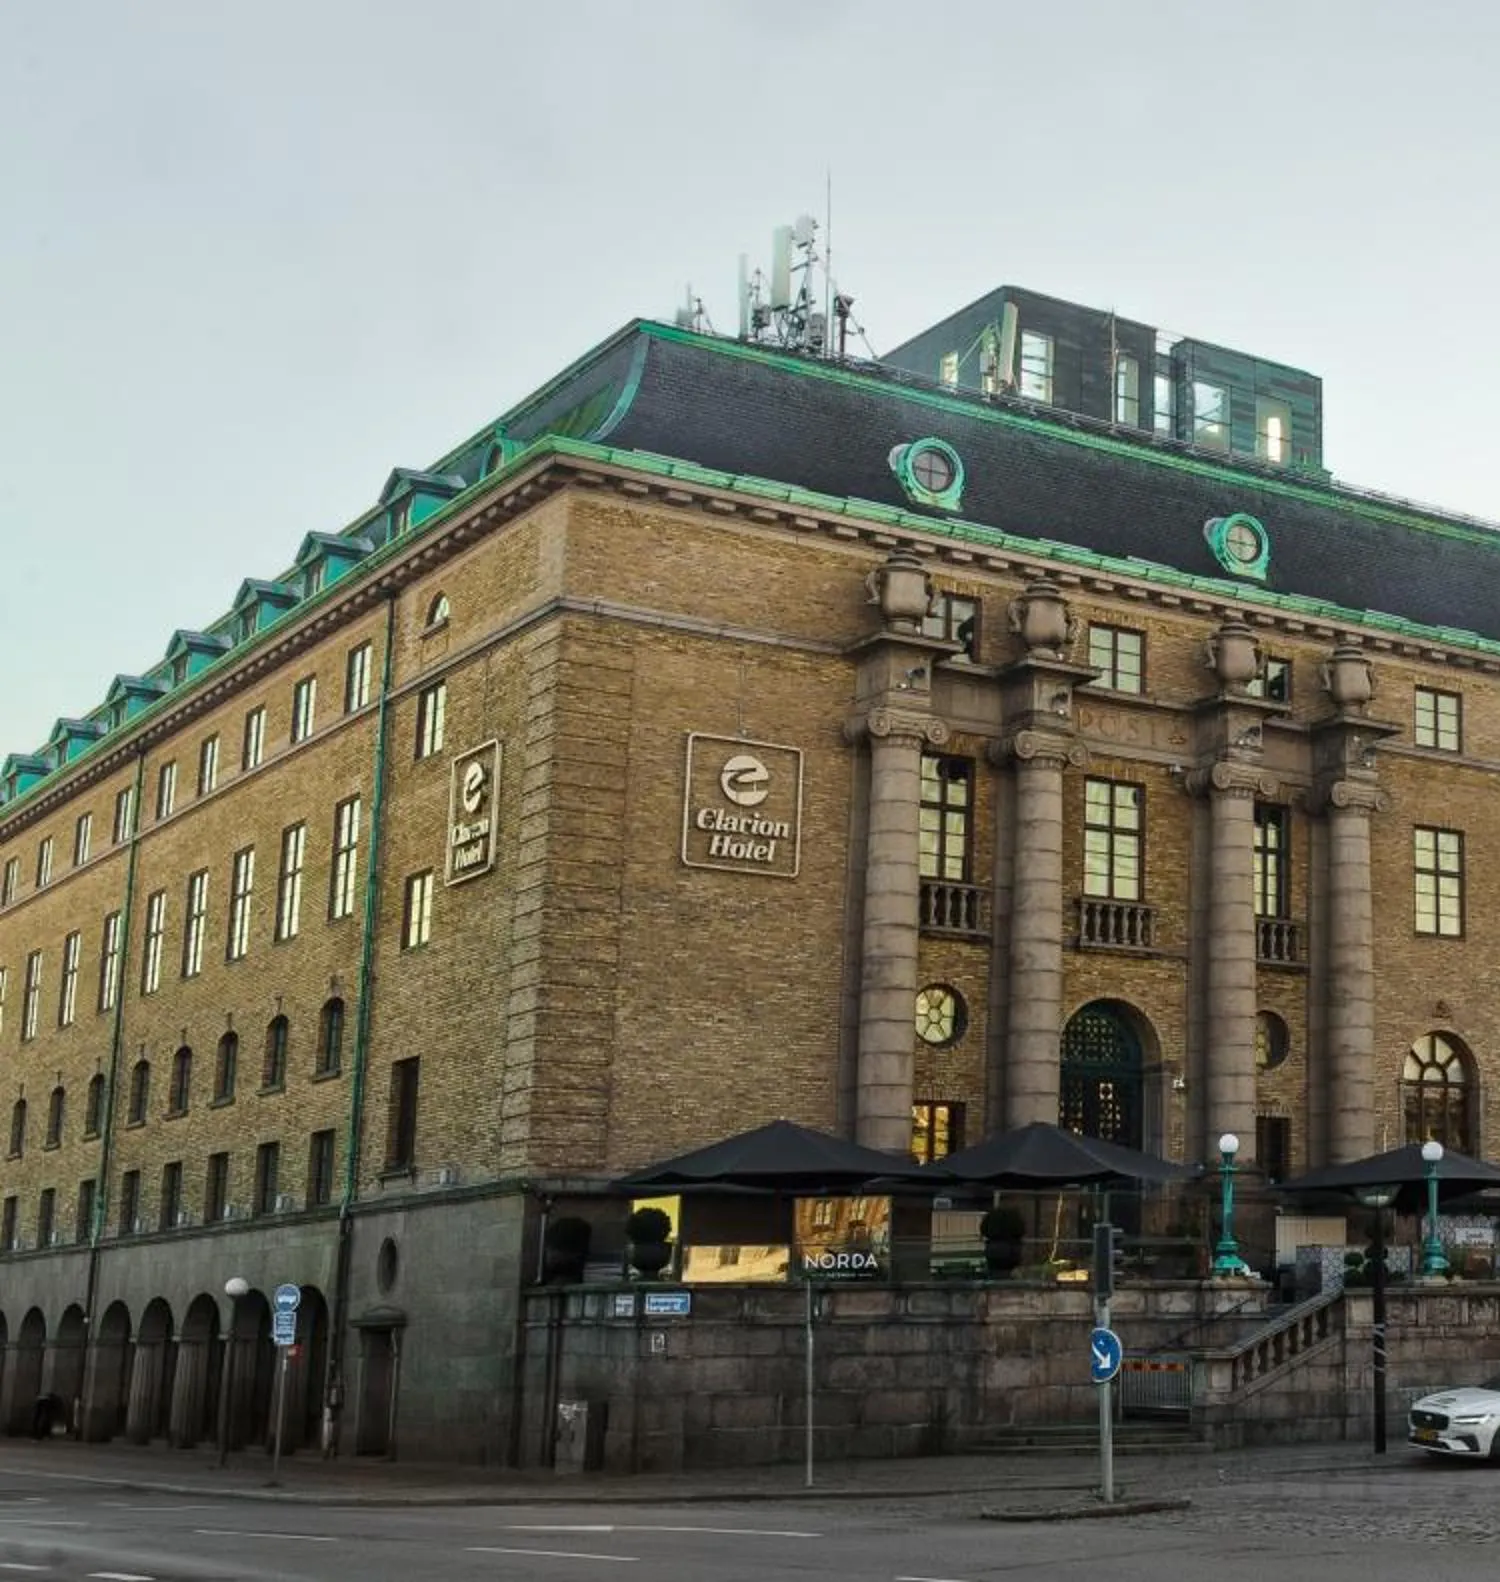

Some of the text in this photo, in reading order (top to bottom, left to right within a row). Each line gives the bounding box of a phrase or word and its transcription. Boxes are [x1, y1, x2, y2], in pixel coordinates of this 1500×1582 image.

[697, 808, 788, 837] Clarion
[709, 834, 776, 861] Hotel
[804, 1253, 878, 1269] NORDA
